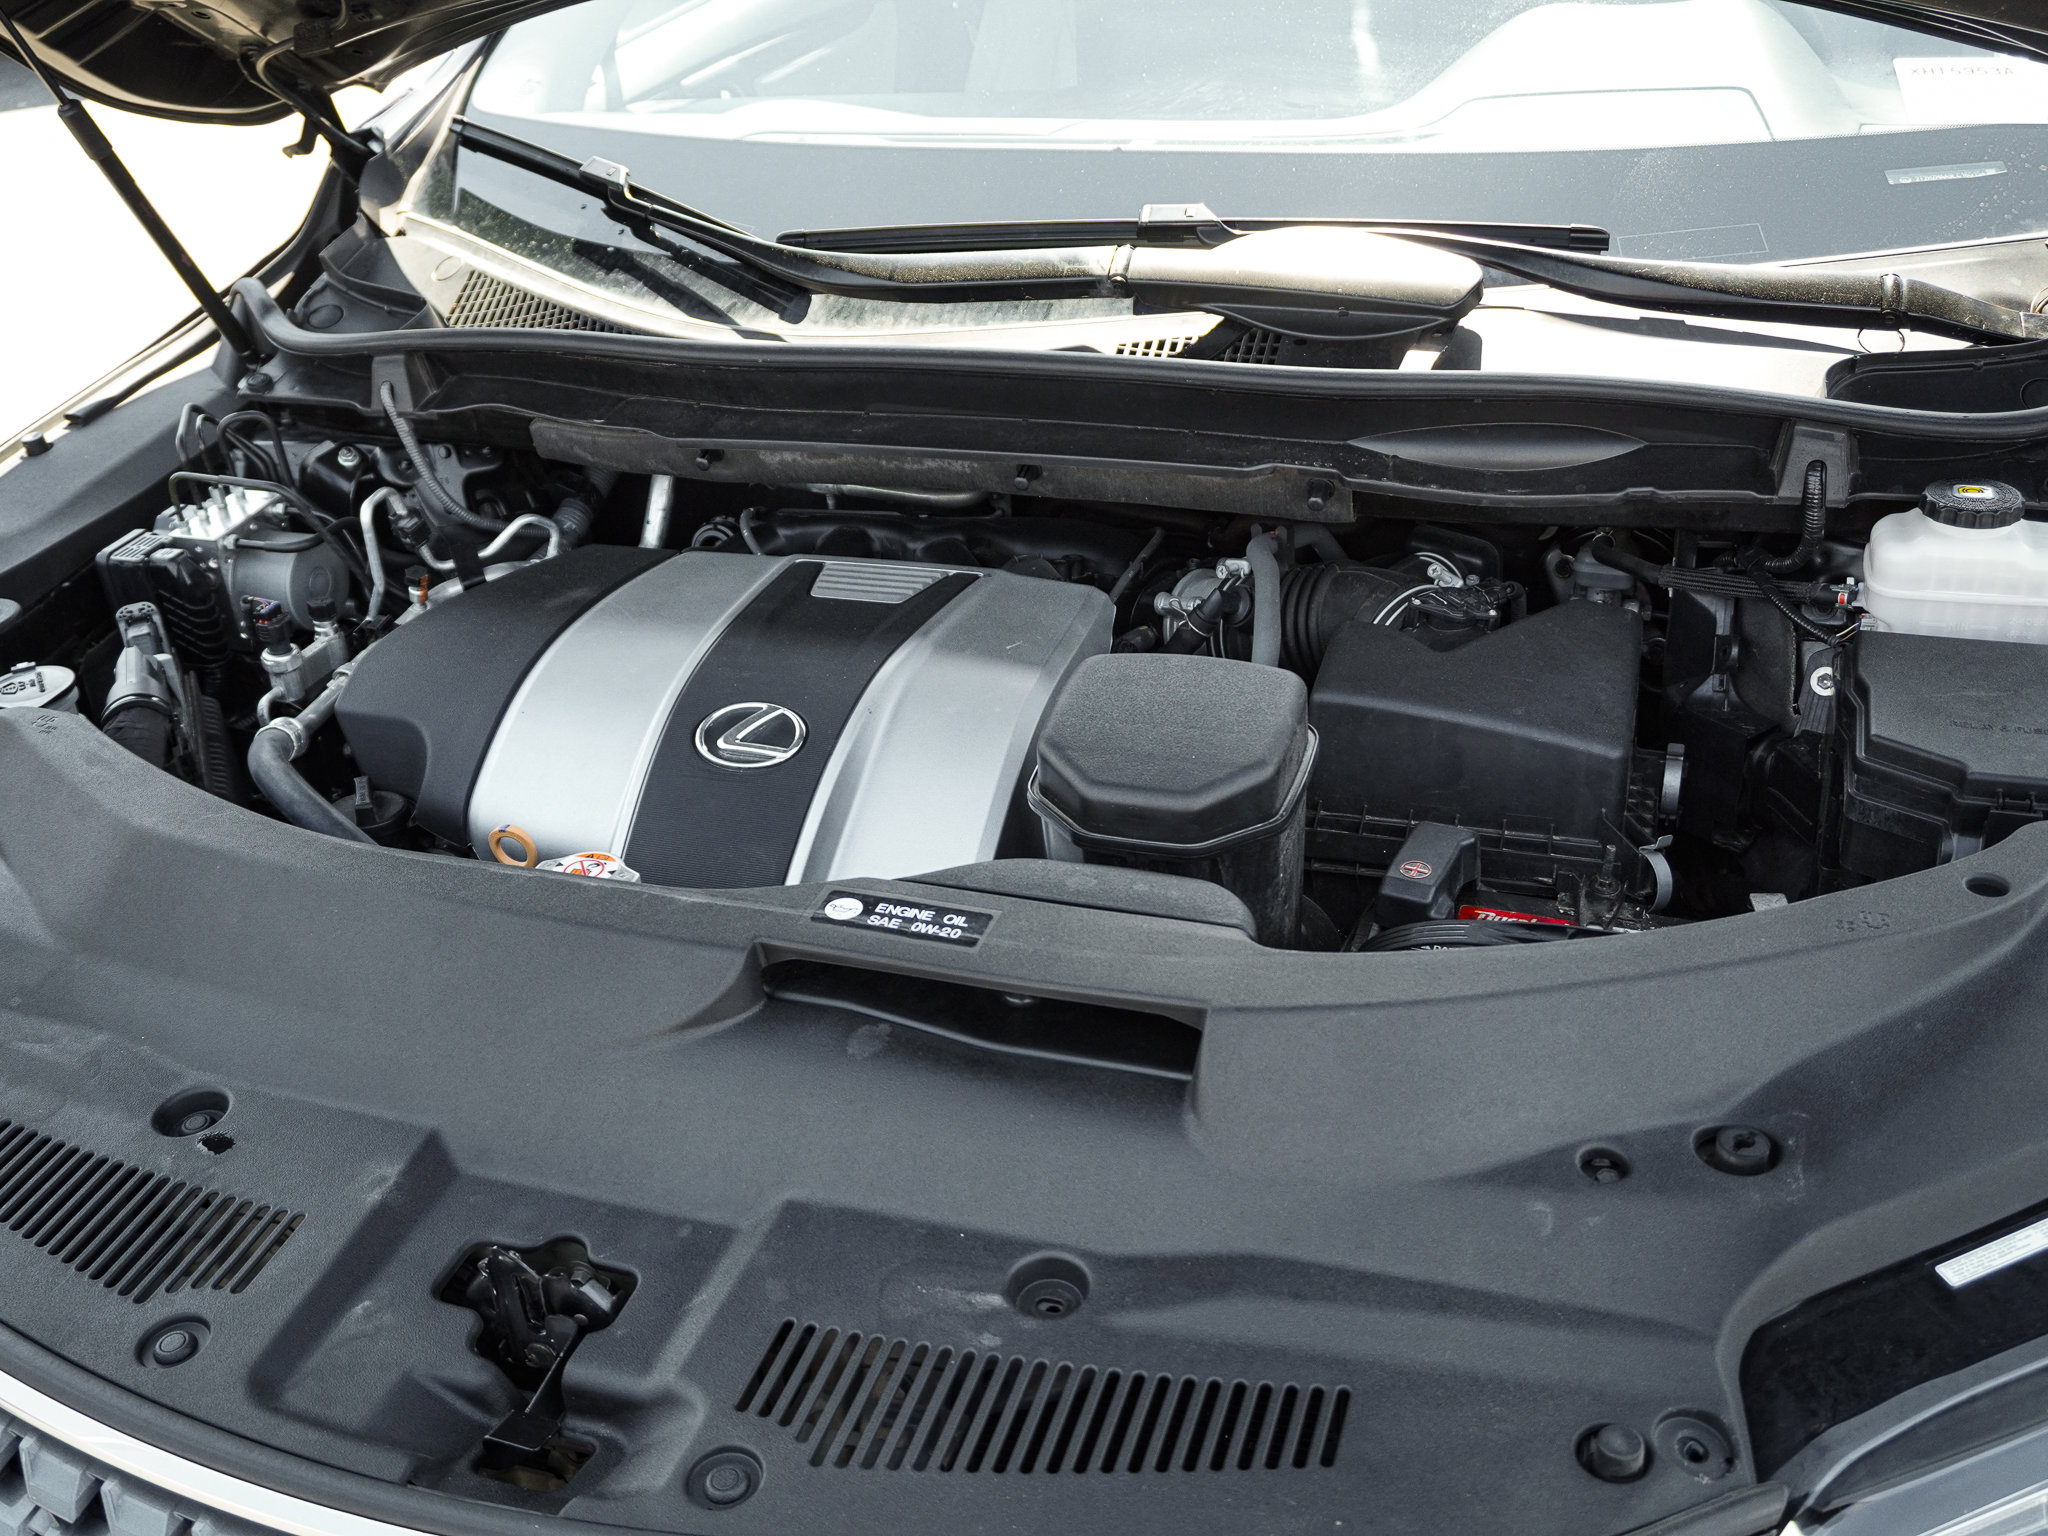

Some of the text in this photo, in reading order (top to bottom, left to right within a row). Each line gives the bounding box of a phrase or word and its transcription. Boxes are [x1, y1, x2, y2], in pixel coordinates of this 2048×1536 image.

[867, 915, 963, 939] SAE 0W-20
[874, 902, 969, 928] ENGINE OIL
